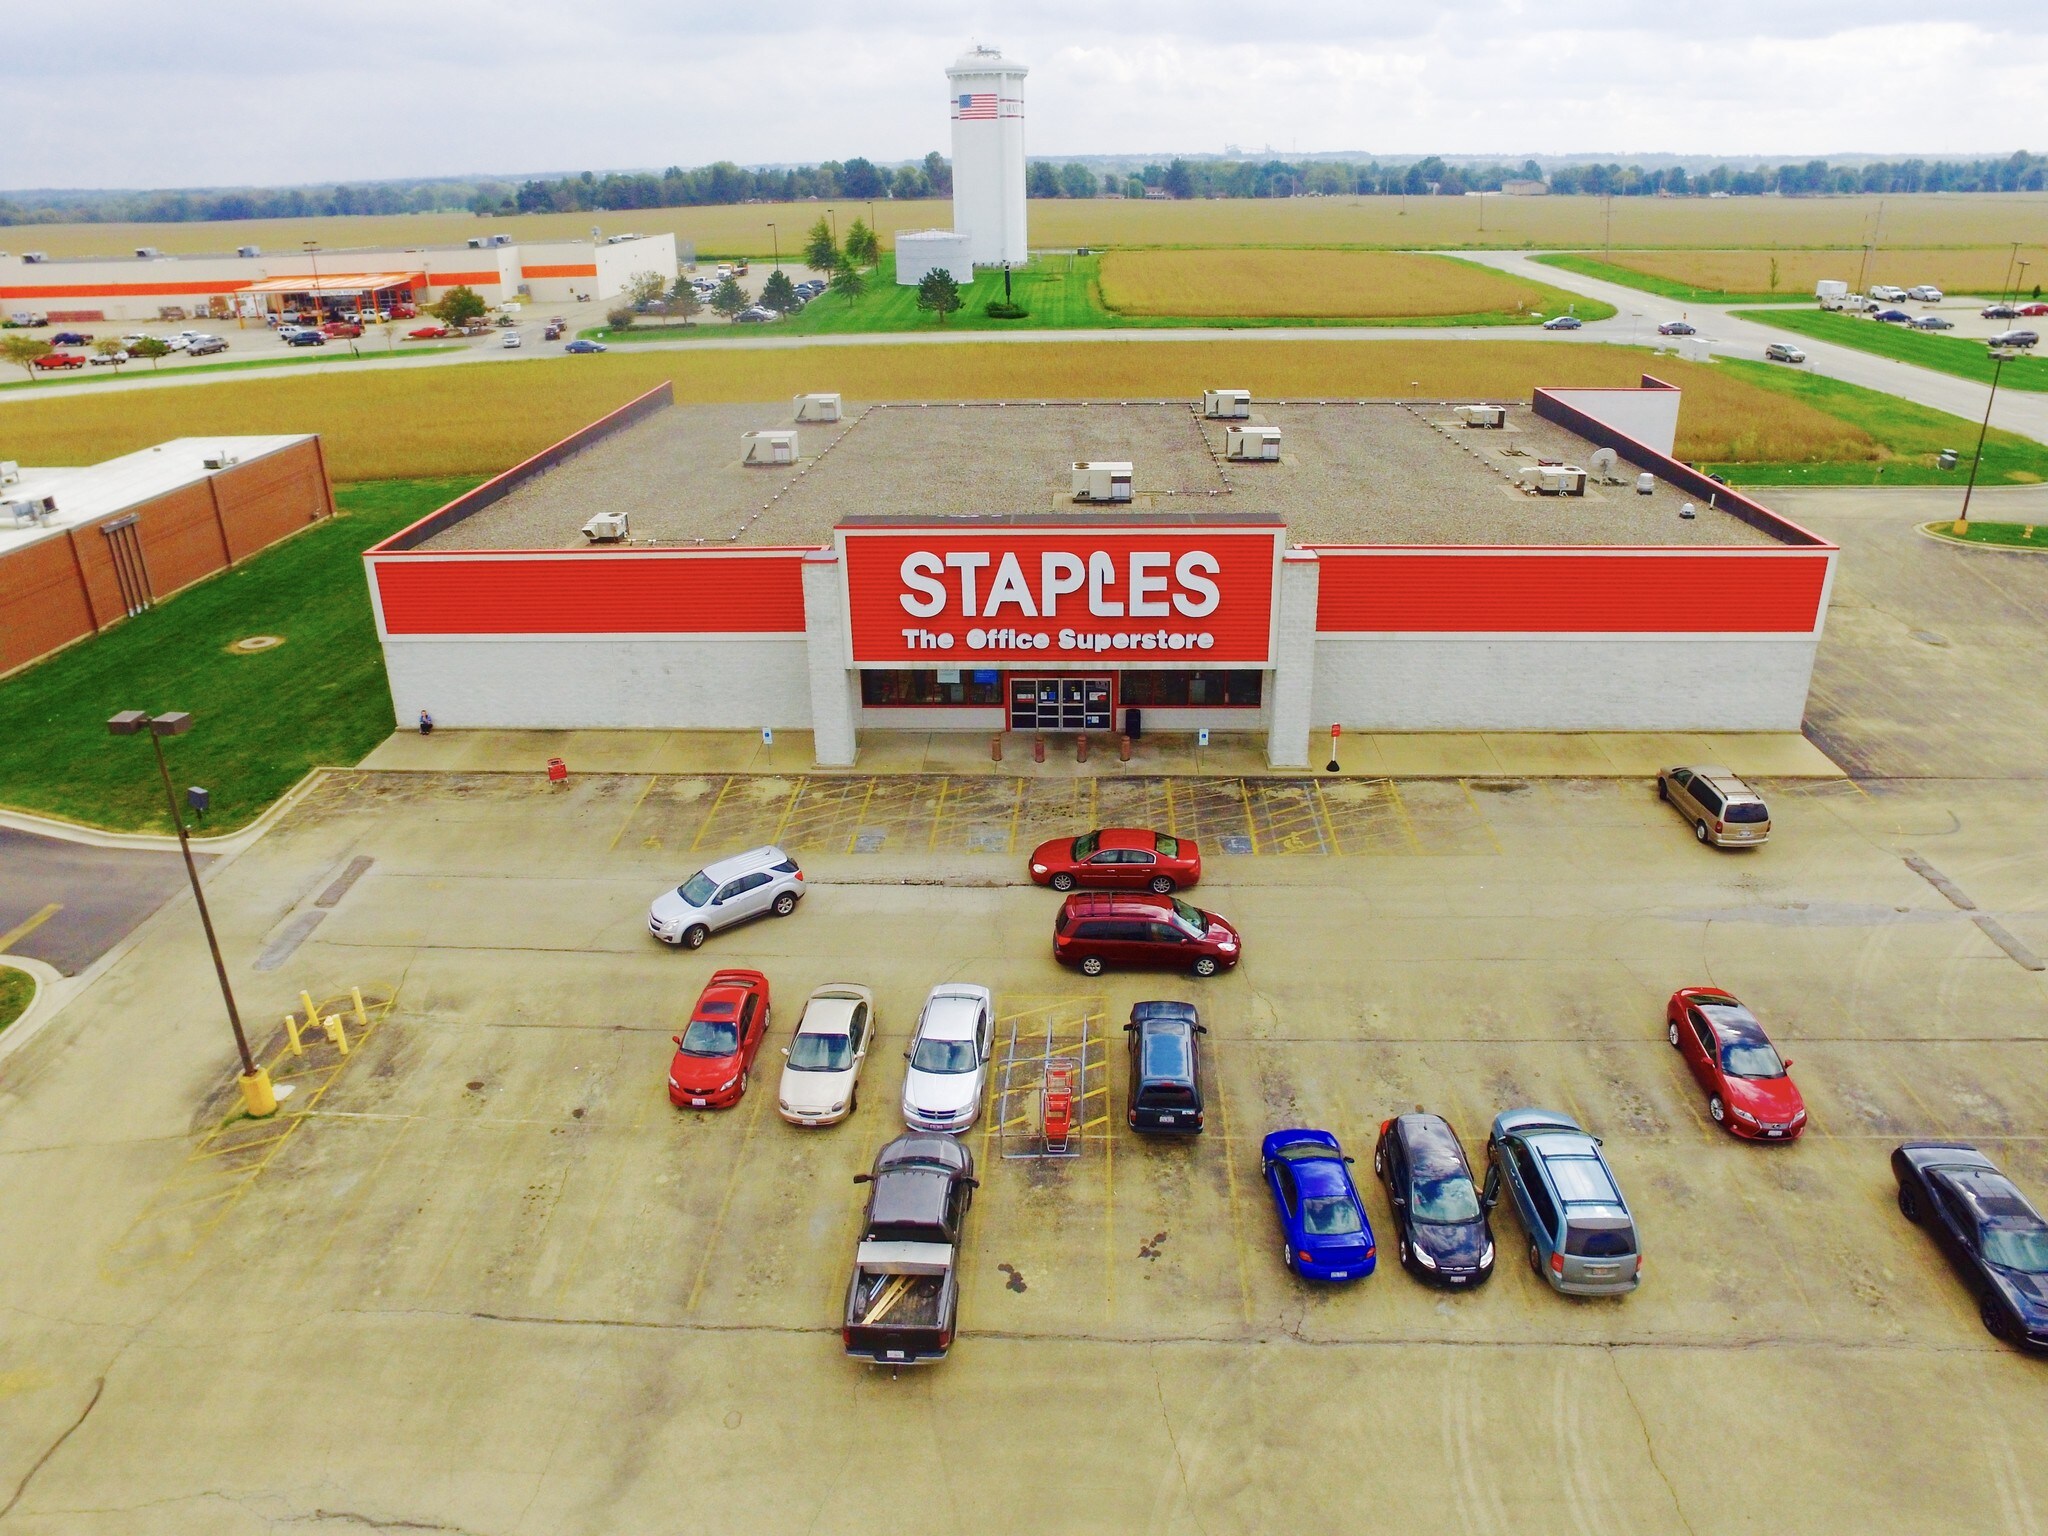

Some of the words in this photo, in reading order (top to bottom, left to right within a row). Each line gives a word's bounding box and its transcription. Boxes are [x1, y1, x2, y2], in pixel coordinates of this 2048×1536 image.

[899, 551, 1220, 618] STAPLES
[902, 629, 955, 650] The
[966, 629, 1050, 650] Office
[1058, 629, 1215, 653] Superstore
